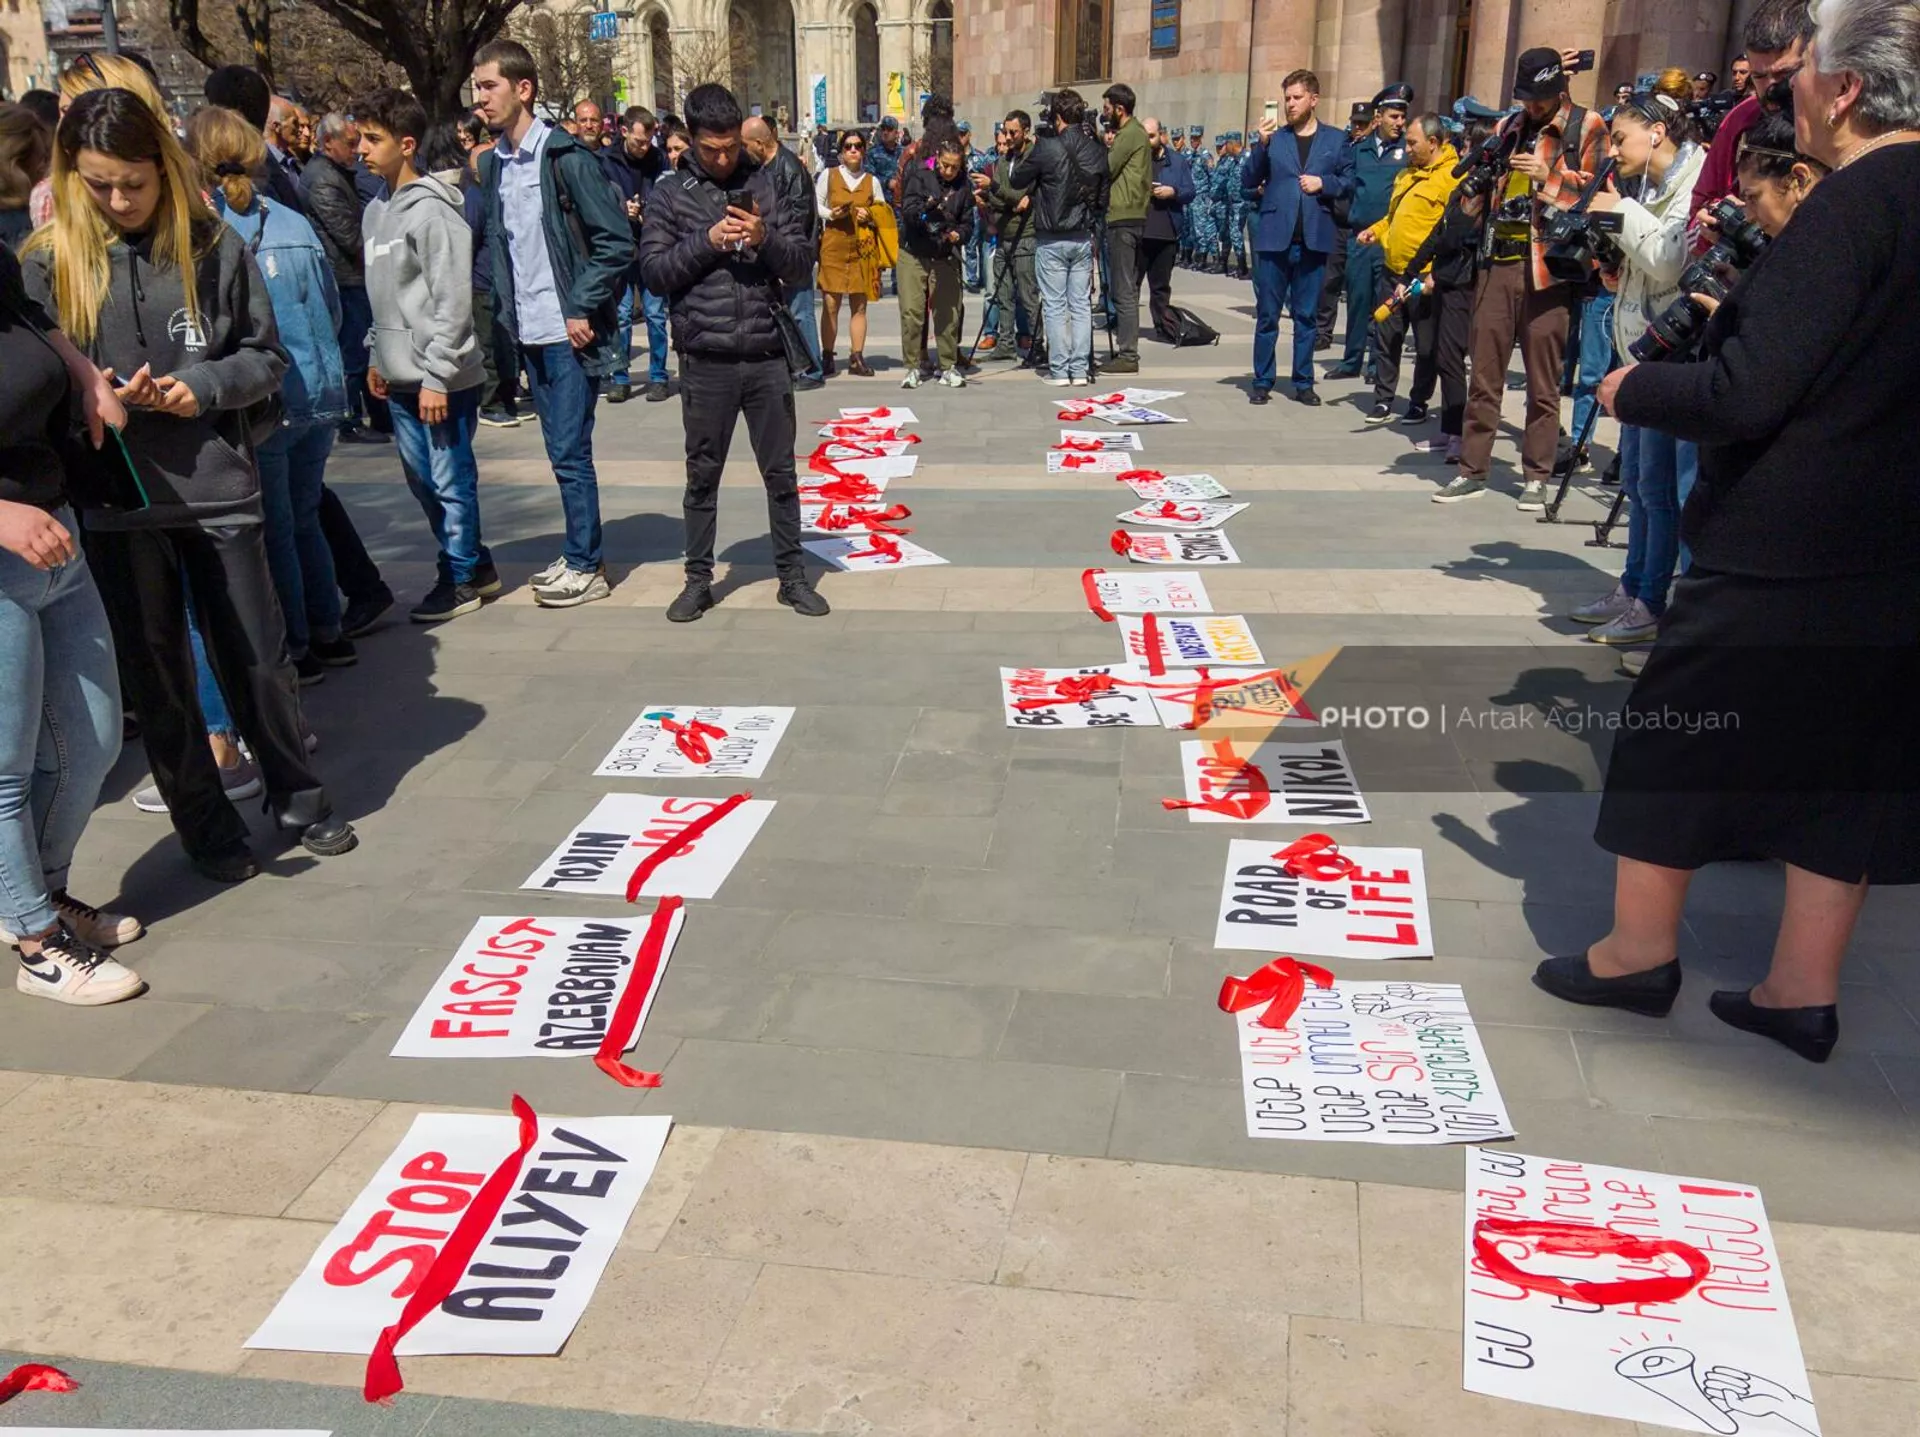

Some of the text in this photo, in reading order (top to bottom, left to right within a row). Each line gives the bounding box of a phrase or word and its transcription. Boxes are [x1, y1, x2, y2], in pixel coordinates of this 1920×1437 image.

[541, 831, 632, 888] NIKOL
[1225, 865, 1300, 927] ROAD
[1305, 887, 1347, 910] OF
[430, 917, 556, 1039] FASCIST
[533, 922, 632, 1051] AZERBAIJAN
[1360, 1040, 1425, 1083] ՏԵՐ
[1253, 1077, 1307, 1131] ՄԵՆՔ
[1313, 1085, 1375, 1133] ՄԵՆՔ
[1375, 1090, 1440, 1135] ՄԵՆՔ
[322, 1151, 487, 1299] STOP
[441, 1126, 629, 1321] ALIYEV
[1475, 1319, 1535, 1370] ԵՍ
